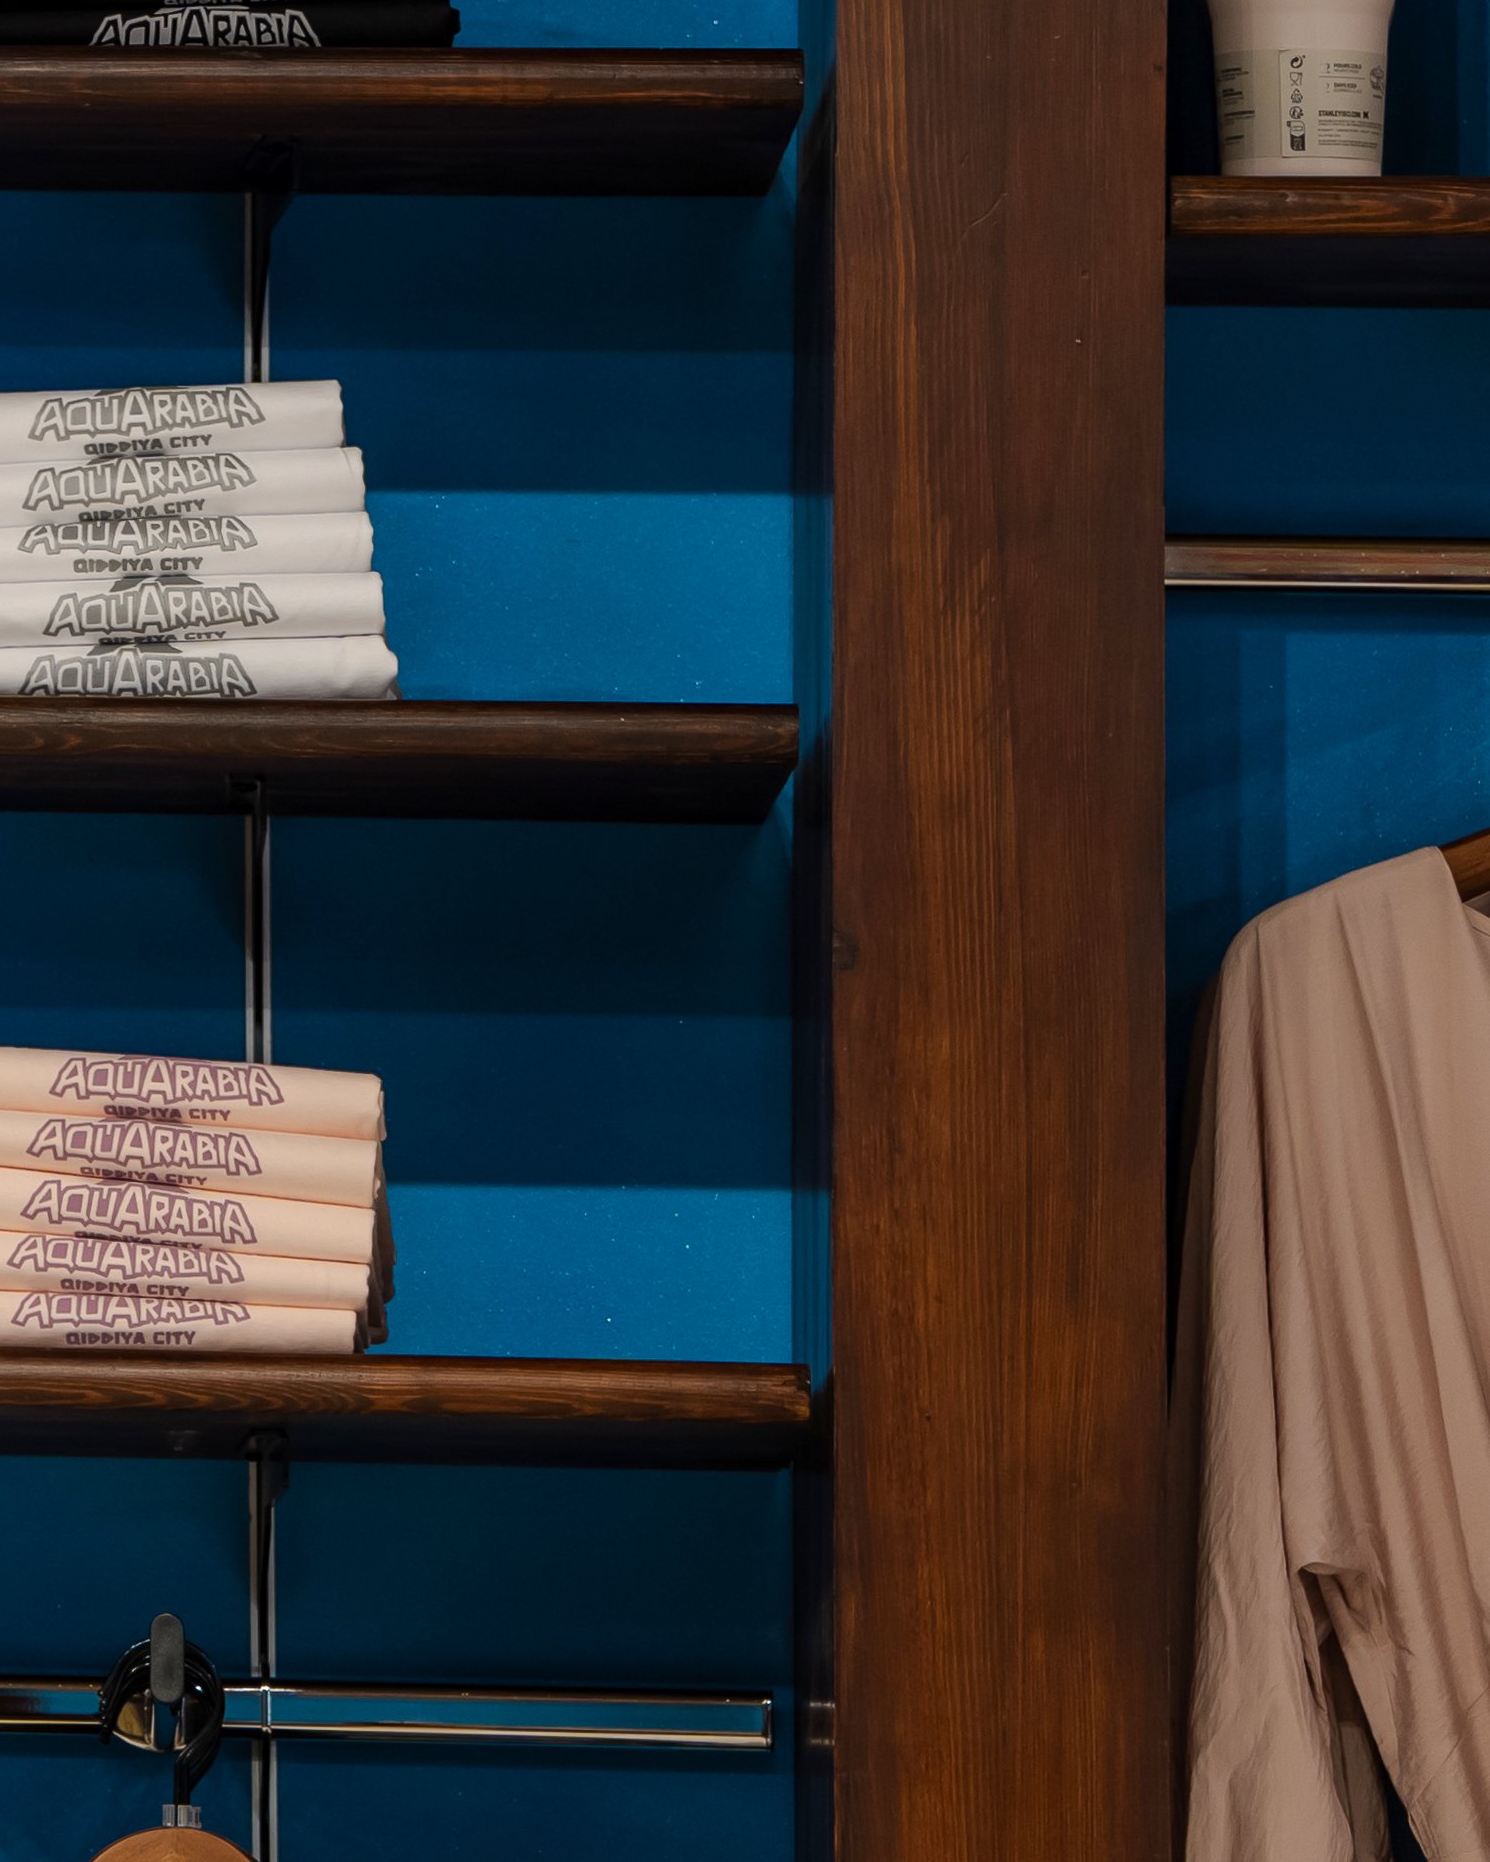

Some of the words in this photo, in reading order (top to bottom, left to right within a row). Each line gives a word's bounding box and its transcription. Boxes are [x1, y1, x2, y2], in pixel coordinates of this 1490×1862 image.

[89, 6, 322, 47] AQUARABIA
[28, 387, 266, 441] AQUARABIA
[84, 438, 163, 455] QIDDIYA
[170, 434, 212, 448] CITY
[22, 453, 257, 511] AQUARABIA
[164, 499, 205, 514] CITY
[18, 516, 258, 555] AQUARABIA
[74, 558, 153, 573] QIDDIYA
[160, 557, 203, 570] CITY
[43, 582, 279, 636] AQUARABIA
[184, 631, 227, 640] CITY
[17, 647, 258, 697] AQUARABIA
[49, 1057, 284, 1106] AQUARABIA
[104, 1105, 182, 1119] QIDDIYA
[189, 1108, 231, 1121] CITY
[26, 1119, 262, 1176] AQUARABIA
[80, 1166, 160, 1182] QIDDIYA
[165, 1174, 207, 1185] CITY
[20, 1179, 257, 1244] AQUARABIA
[6, 1234, 245, 1284] AQUARABIA
[60, 1278, 139, 1295] QIDDIYA
[147, 1284, 190, 1297] CITY
[66, 1332, 144, 1346] QIDDIYA
[153, 1331, 196, 1345] CITY
